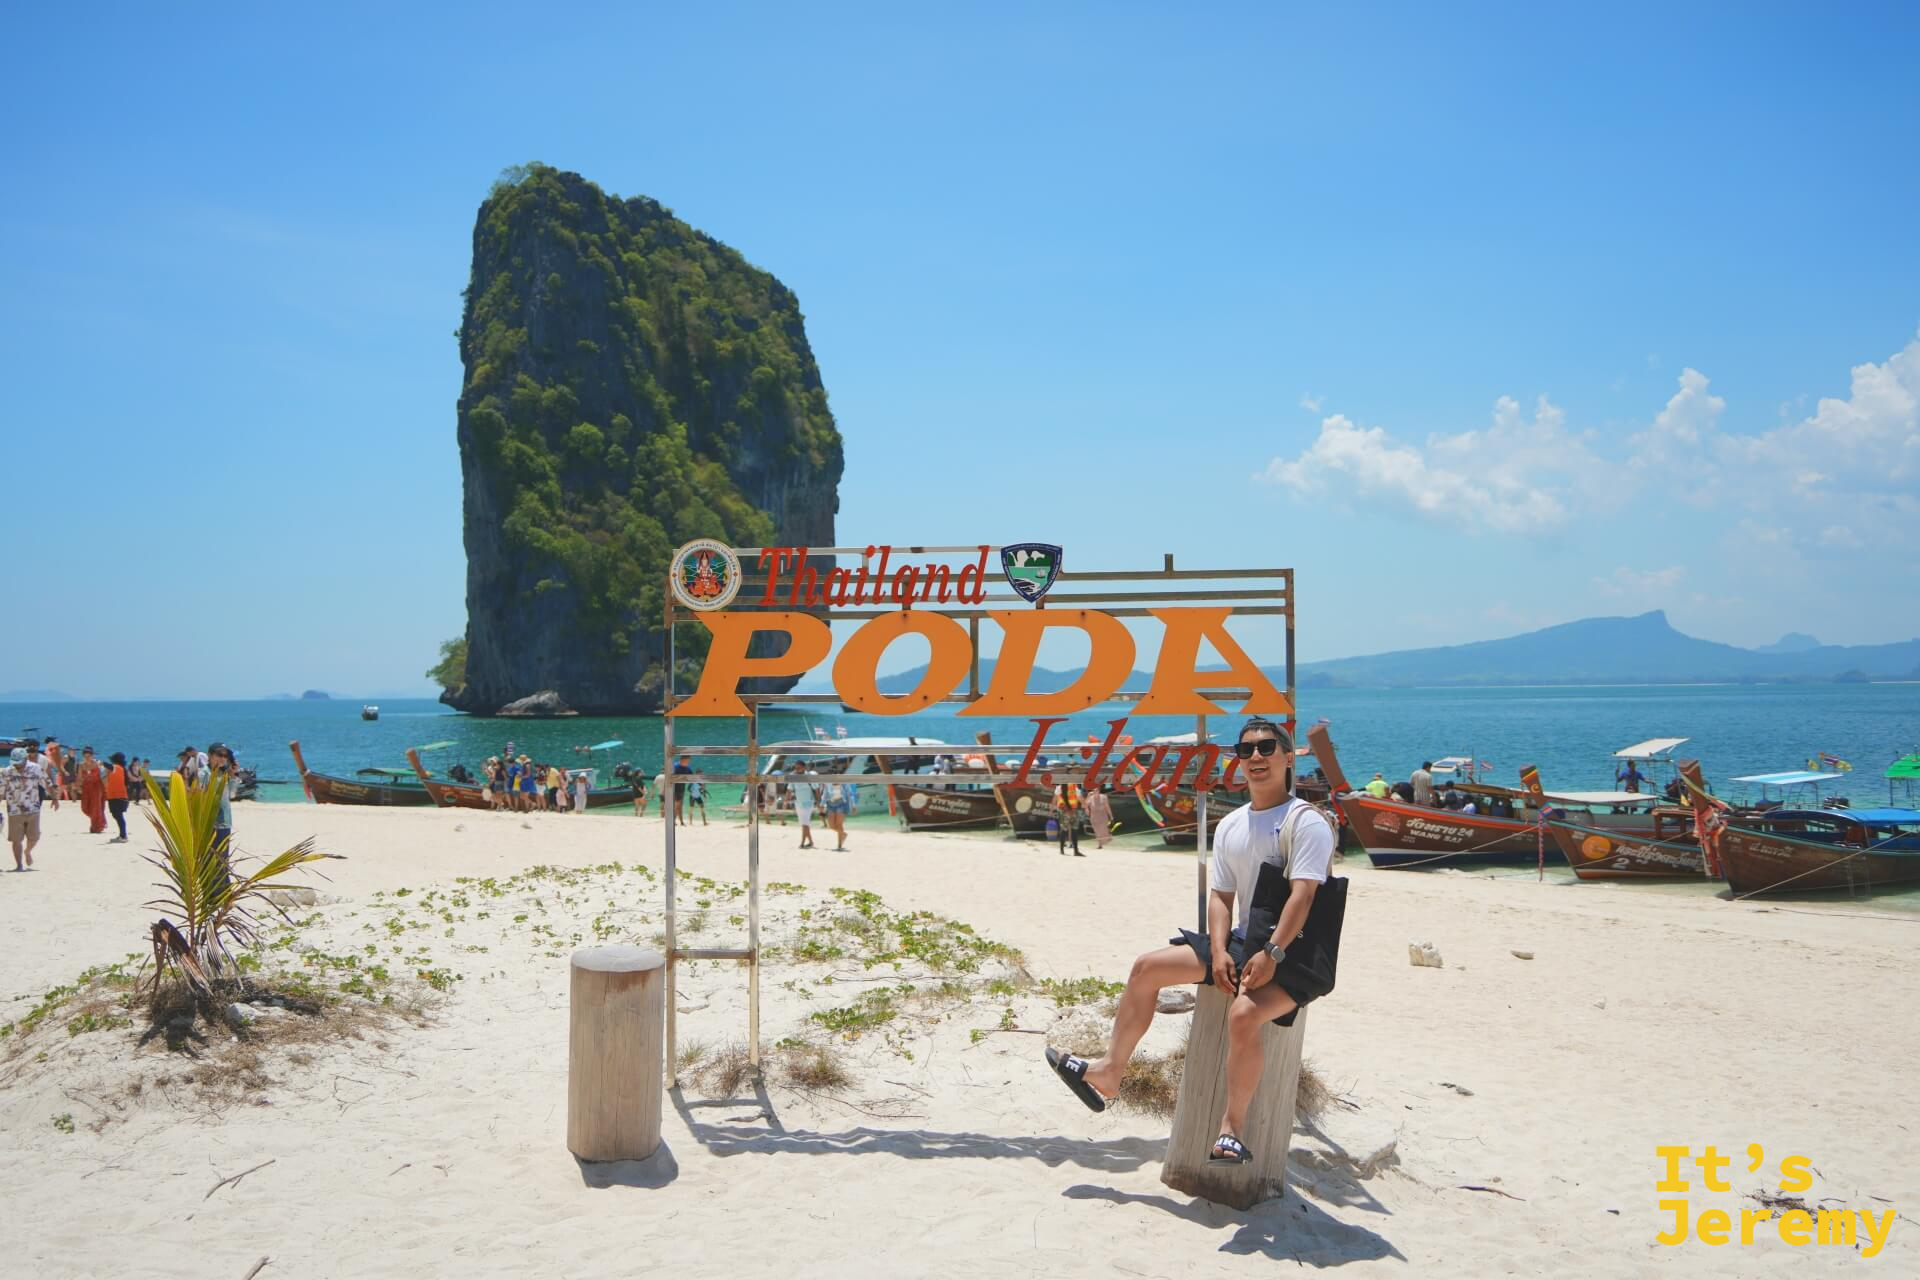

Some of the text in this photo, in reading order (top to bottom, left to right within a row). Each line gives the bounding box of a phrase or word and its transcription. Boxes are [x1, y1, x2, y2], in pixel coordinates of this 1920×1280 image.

[757, 545, 990, 608] Thailand
[664, 607, 1295, 717] PODA
[1409, 829, 1441, 841] WANG
[1457, 827, 1475, 839] 24
[1611, 857, 1631, 870] 2
